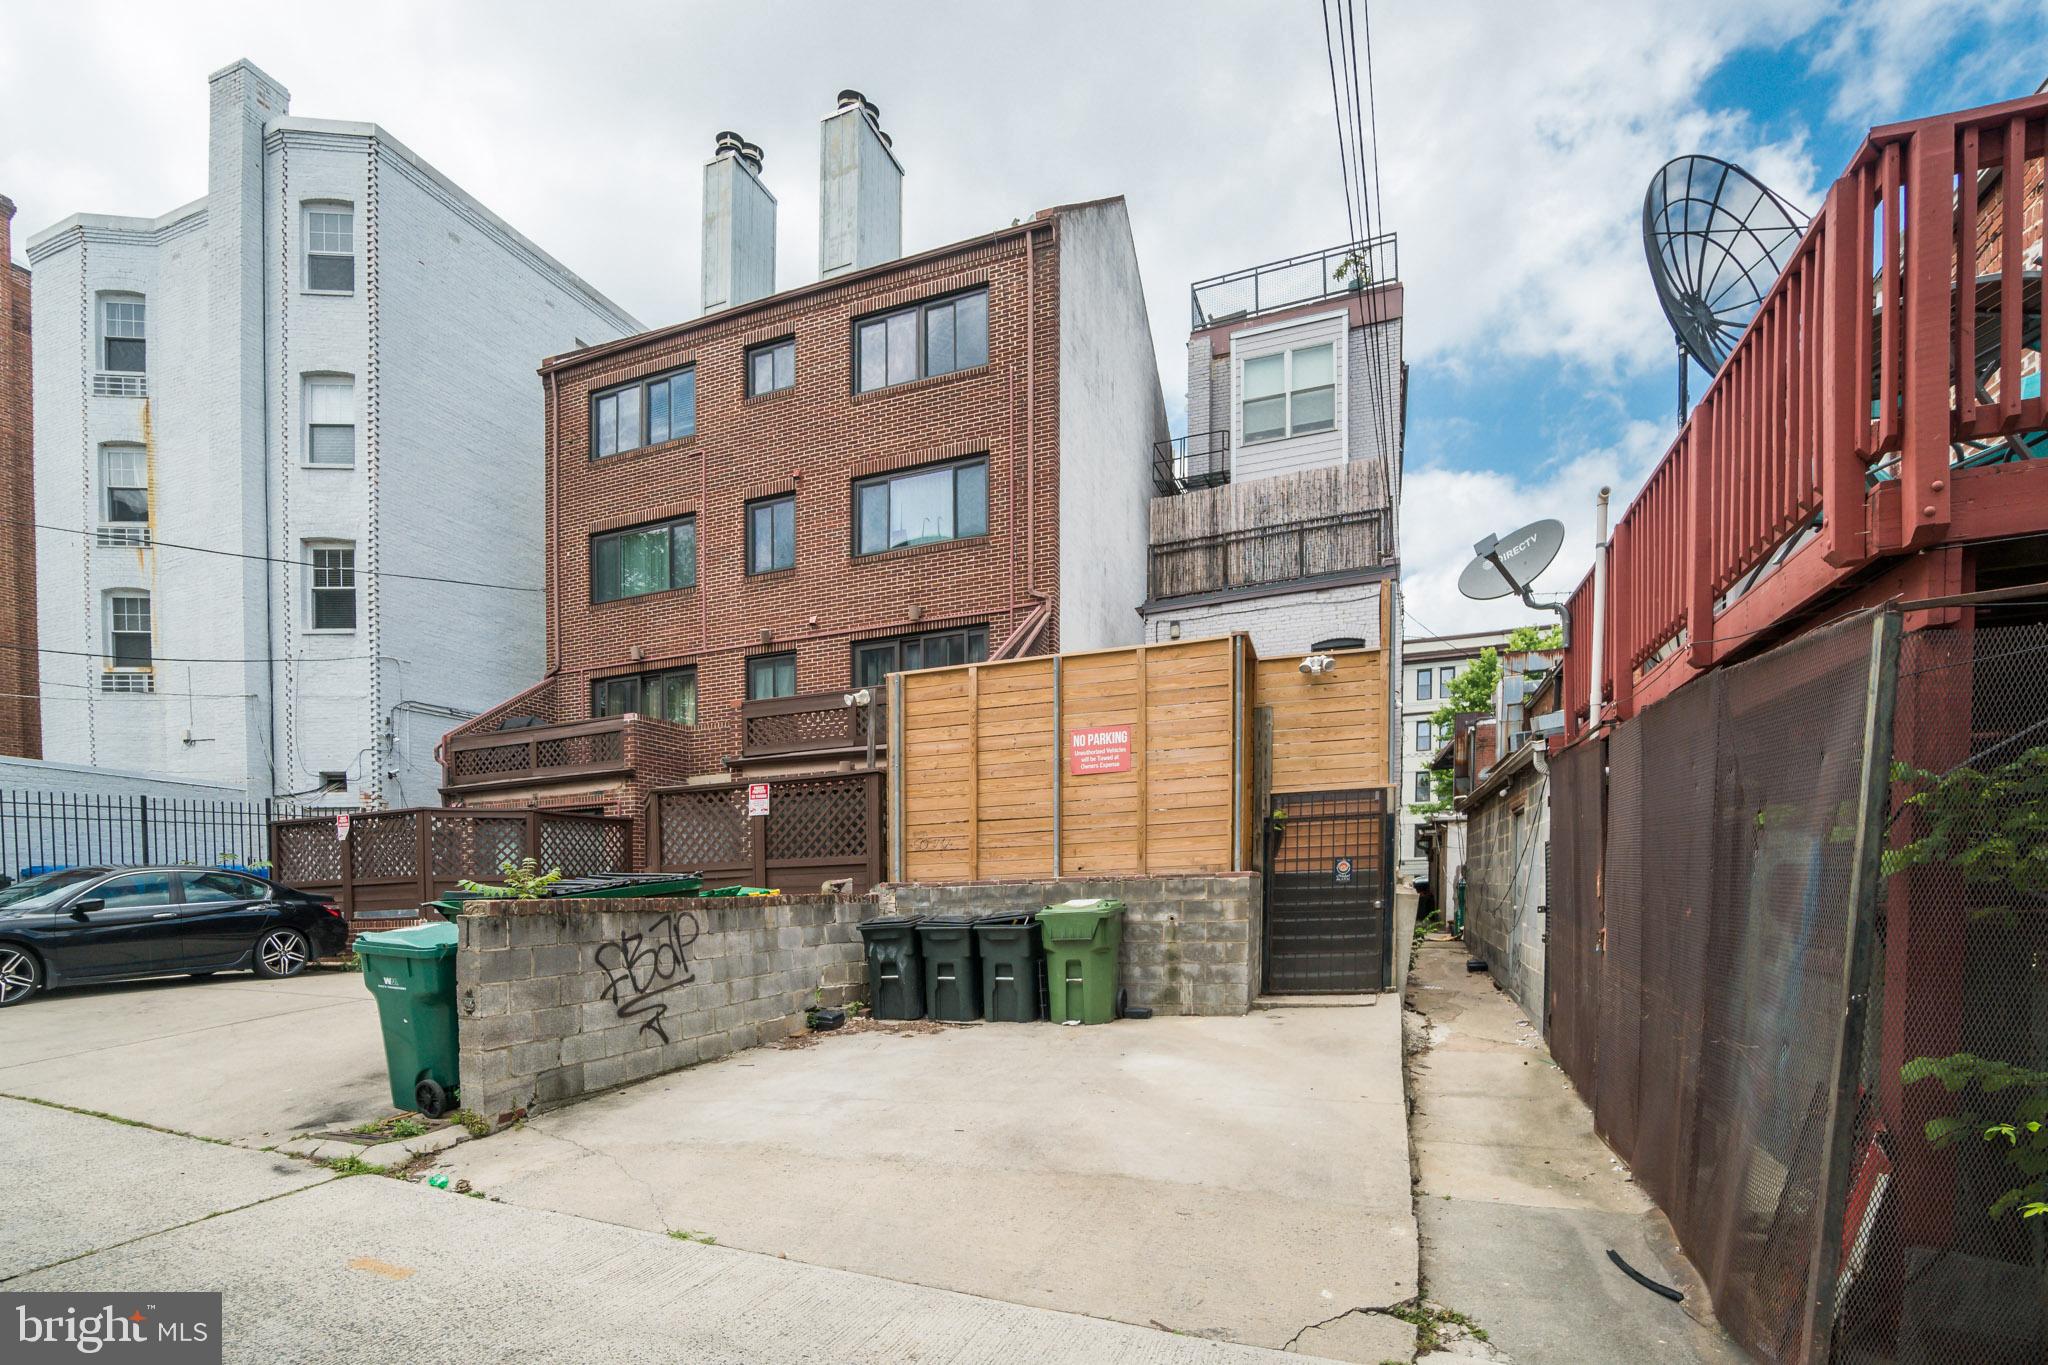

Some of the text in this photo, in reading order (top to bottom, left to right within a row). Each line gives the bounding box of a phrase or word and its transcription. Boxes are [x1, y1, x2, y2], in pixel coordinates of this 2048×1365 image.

[1498, 534, 1537, 562] DIRECTV
[1073, 731, 1128, 746] NO PARKING
[1074, 748, 1106, 756] Unauthorized
